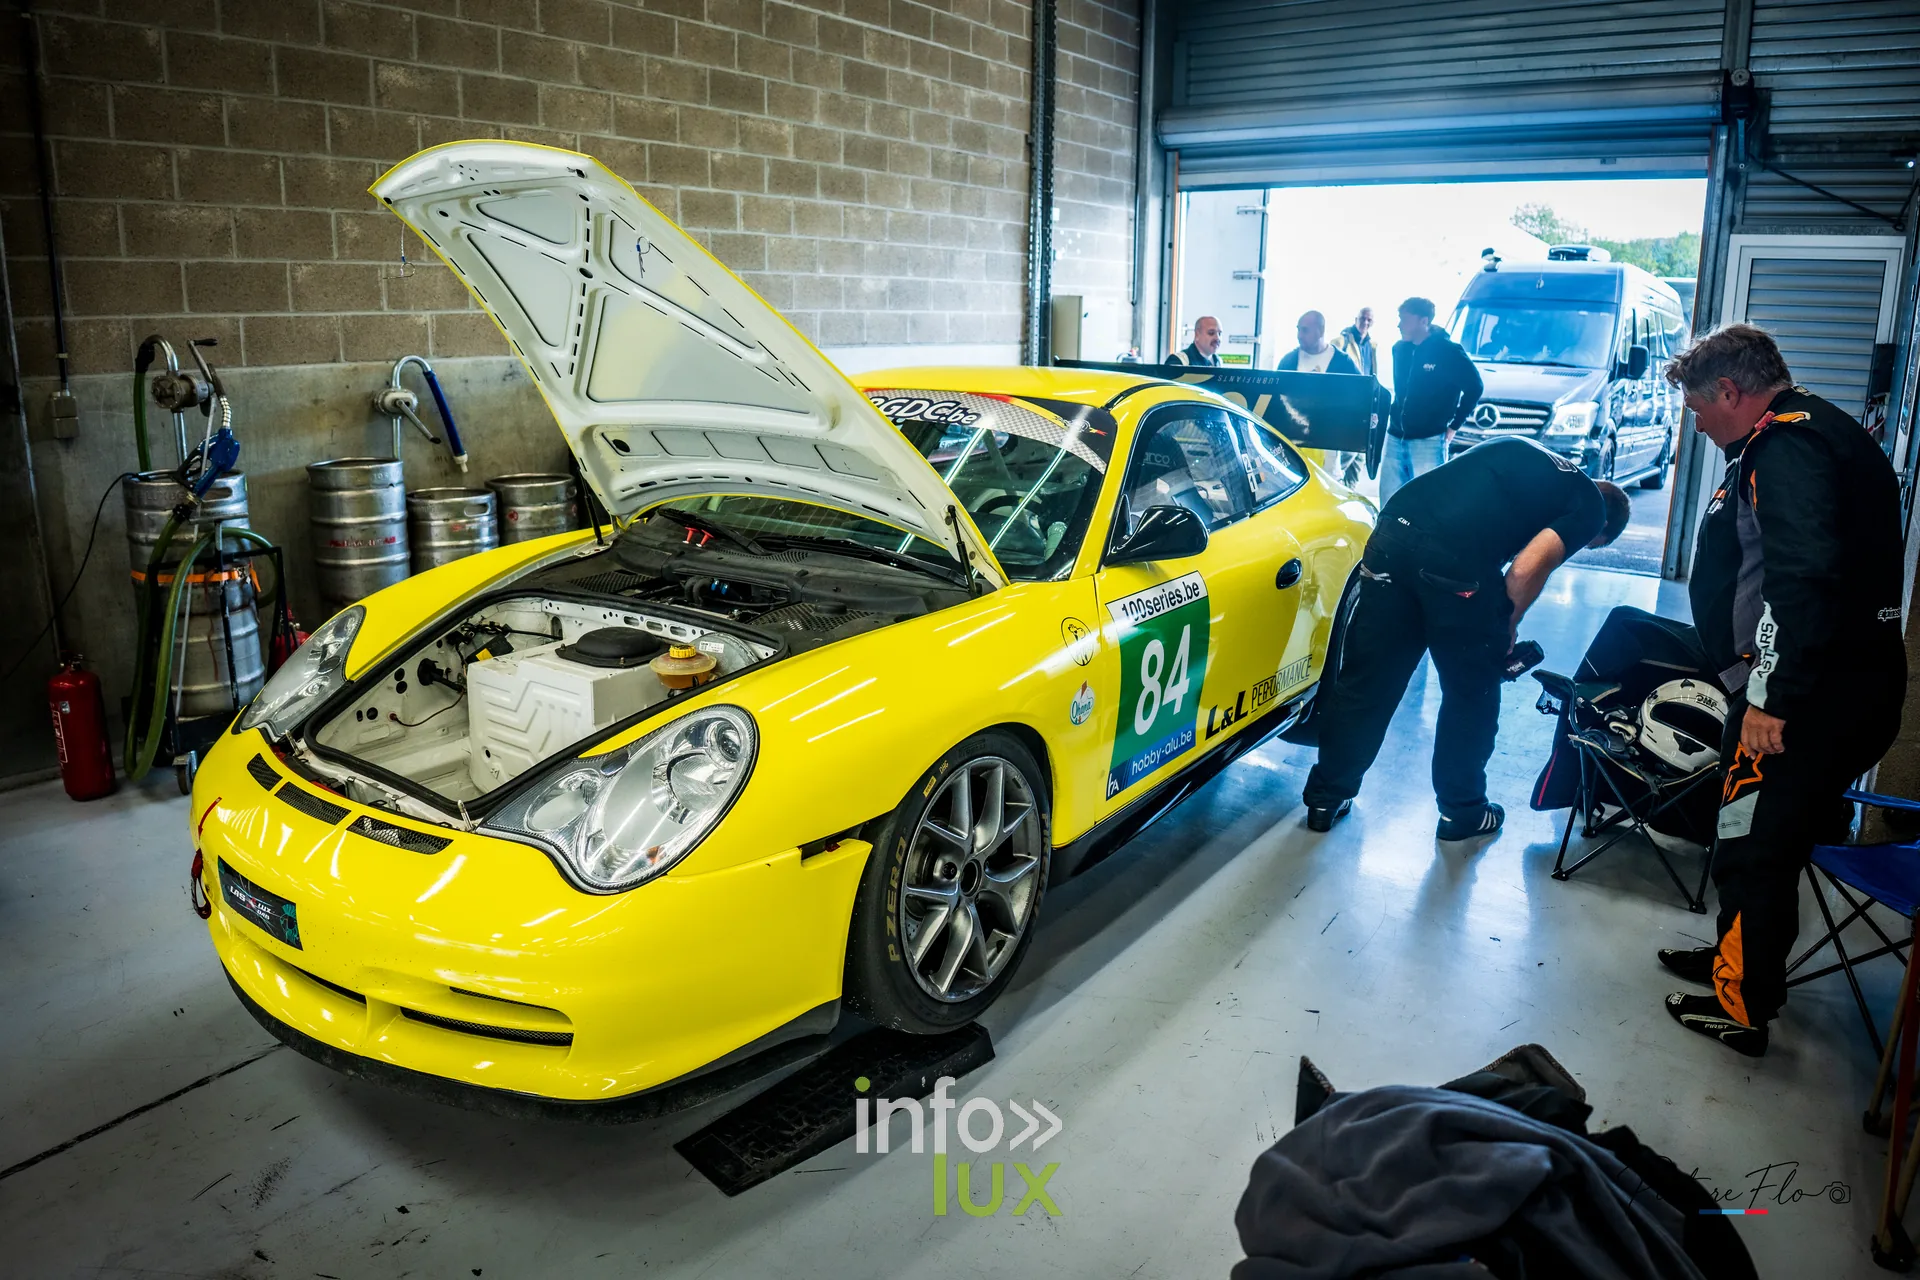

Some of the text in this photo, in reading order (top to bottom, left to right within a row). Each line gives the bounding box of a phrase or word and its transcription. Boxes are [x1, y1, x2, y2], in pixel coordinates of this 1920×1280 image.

[1217, 374, 1280, 385] LUBRIFIANTS
[1143, 452, 1171, 465] arco
[1121, 580, 1201, 622] 100series.be
[1134, 623, 1191, 736] 84
[1205, 656, 1313, 741] L&L PERFORMANCE
[1131, 729, 1193, 776] hobby-alu.be
[886, 836, 907, 962] P ZERO
